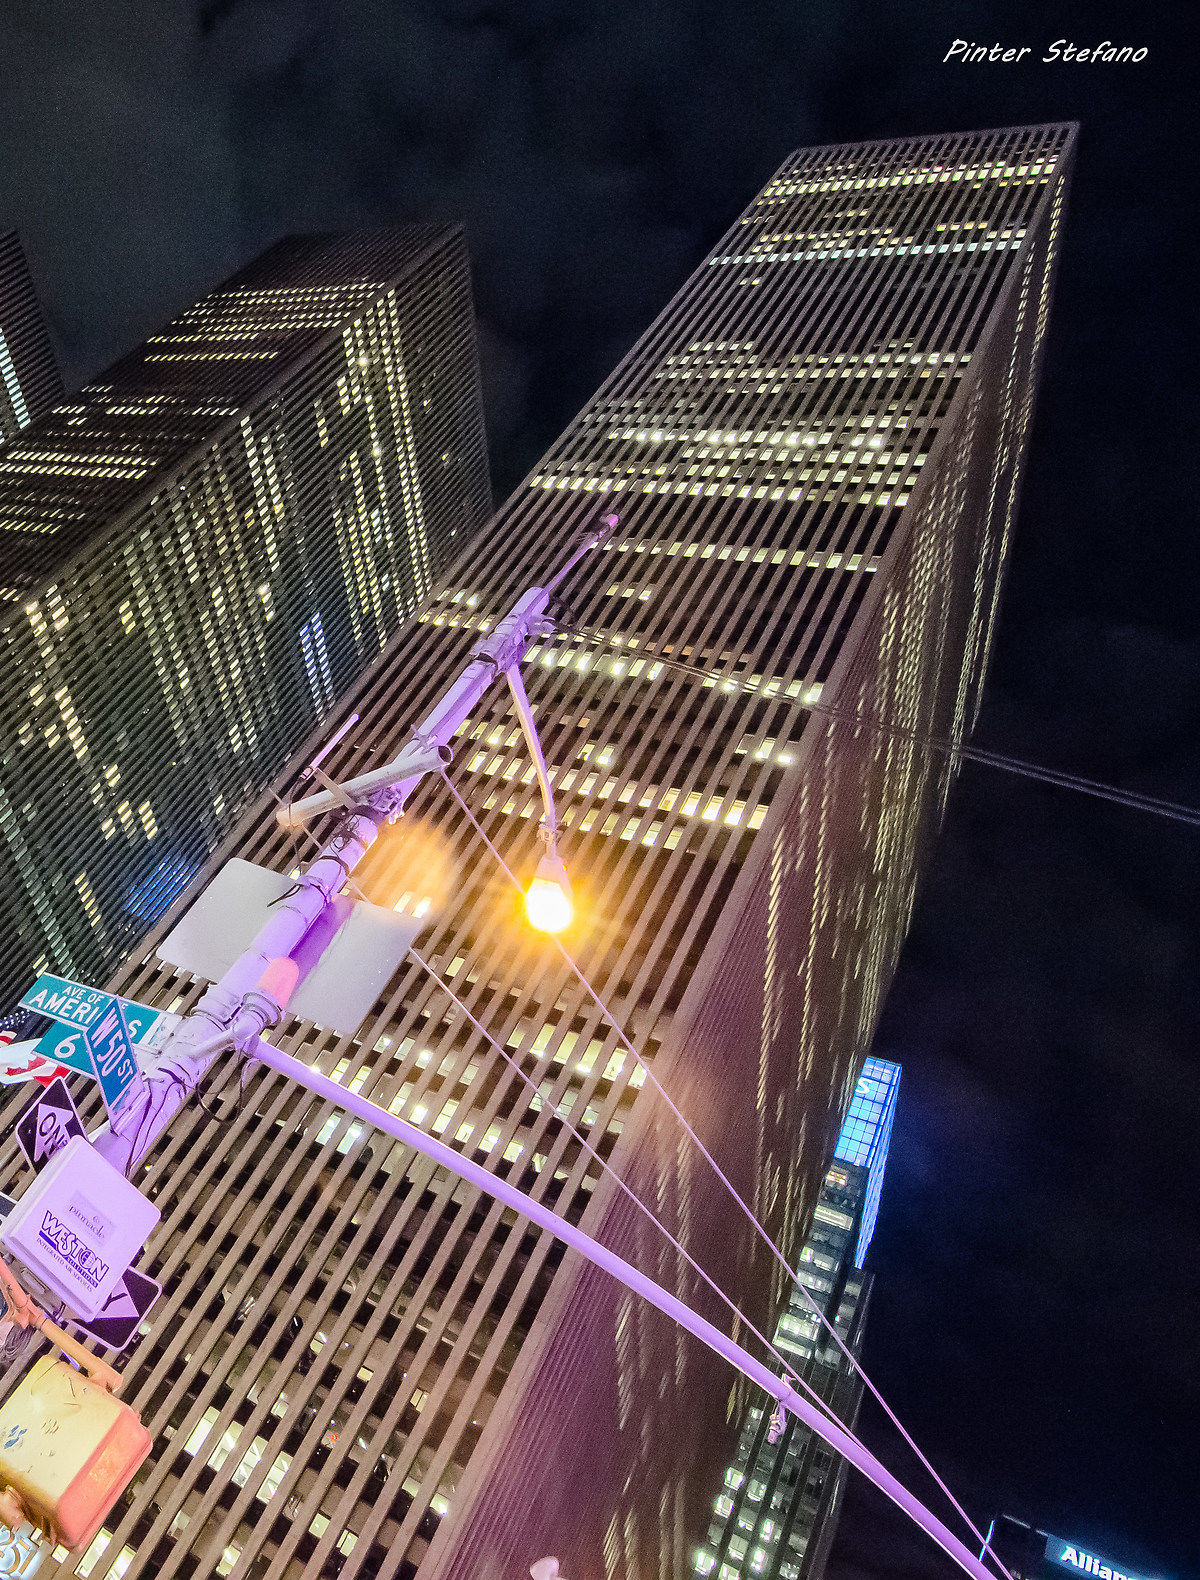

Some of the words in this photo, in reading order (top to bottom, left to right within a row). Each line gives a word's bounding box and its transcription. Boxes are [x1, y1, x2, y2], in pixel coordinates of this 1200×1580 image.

[62, 985, 86, 1000] AVE
[87, 993, 104, 1004] OF
[91, 1007, 119, 1048] W
[54, 1033, 81, 1058] 6
[97, 1029, 127, 1076] 50
[117, 1058, 134, 1084] ST
[41, 1210, 109, 1282] WESTON
